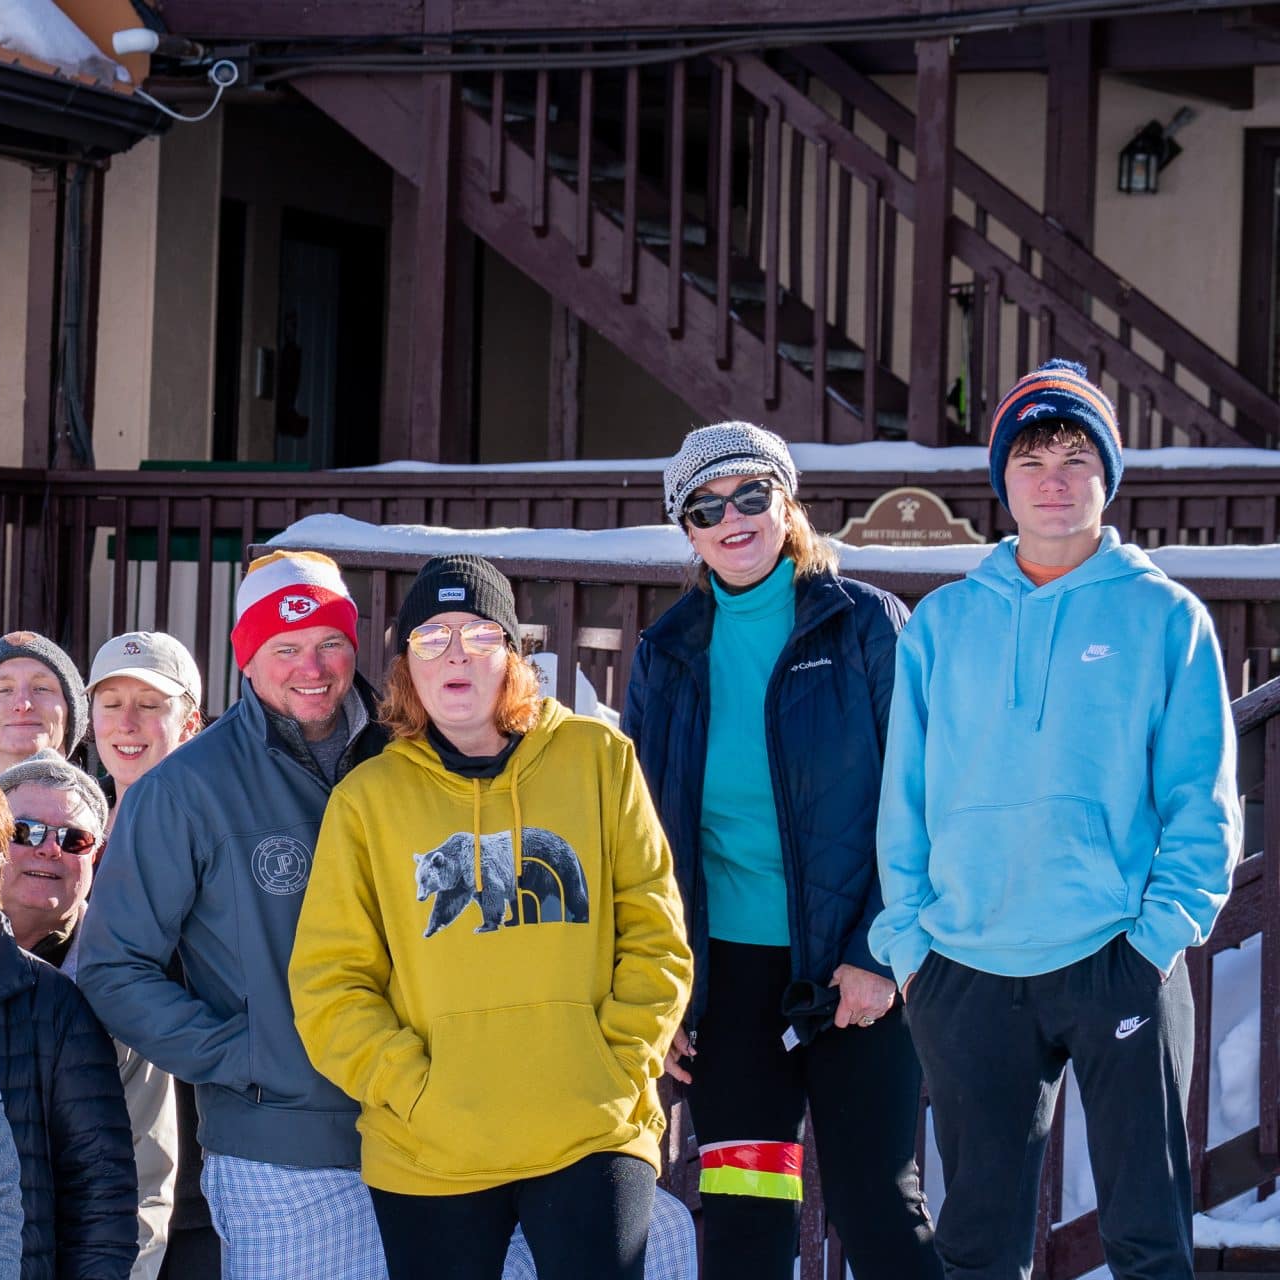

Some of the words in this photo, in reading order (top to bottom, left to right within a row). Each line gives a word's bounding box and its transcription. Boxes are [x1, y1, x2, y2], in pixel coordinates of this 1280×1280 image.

[1087, 644, 1111, 656] NIKE
[798, 657, 832, 670] Columbia
[1119, 1016, 1140, 1031] NIKE
